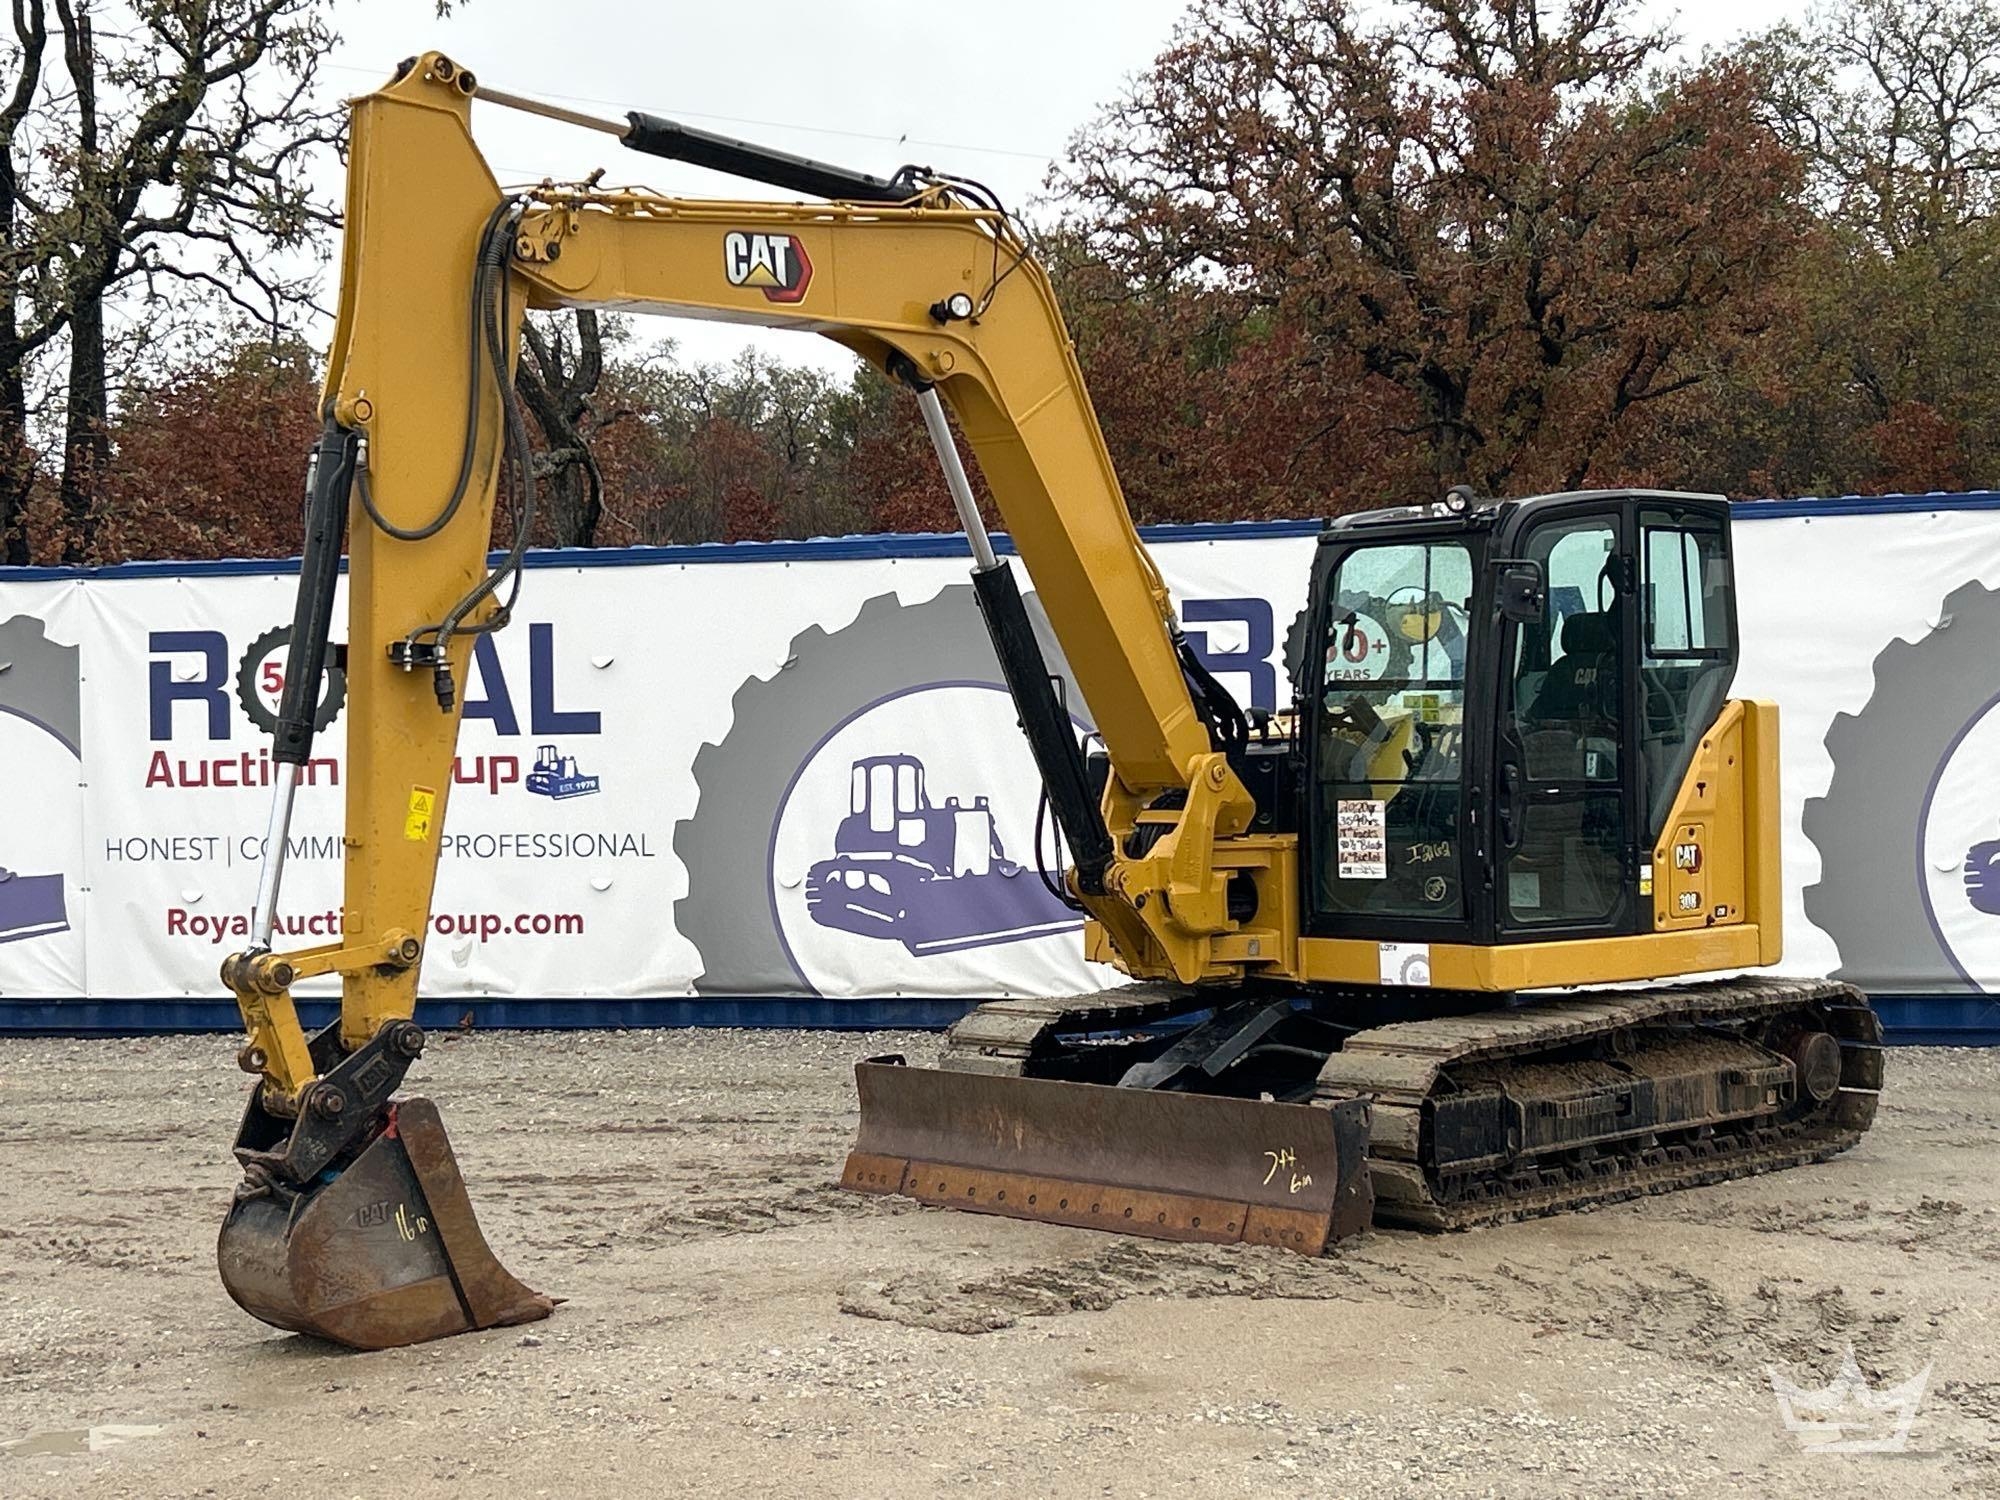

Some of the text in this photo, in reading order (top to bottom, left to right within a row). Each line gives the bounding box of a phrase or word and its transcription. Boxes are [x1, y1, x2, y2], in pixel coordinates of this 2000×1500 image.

[726, 232, 791, 288] CAT
[1327, 668, 1371, 681] YEARS
[145, 748, 339, 788] Auctin
[575, 779, 597, 790] 1970
[106, 837, 220, 861] HONEST
[439, 833, 655, 859] PROFESSIONAL
[1675, 844, 1698, 869] CAT
[1679, 893, 1698, 910] 308
[358, 1201, 389, 1228] CAT
